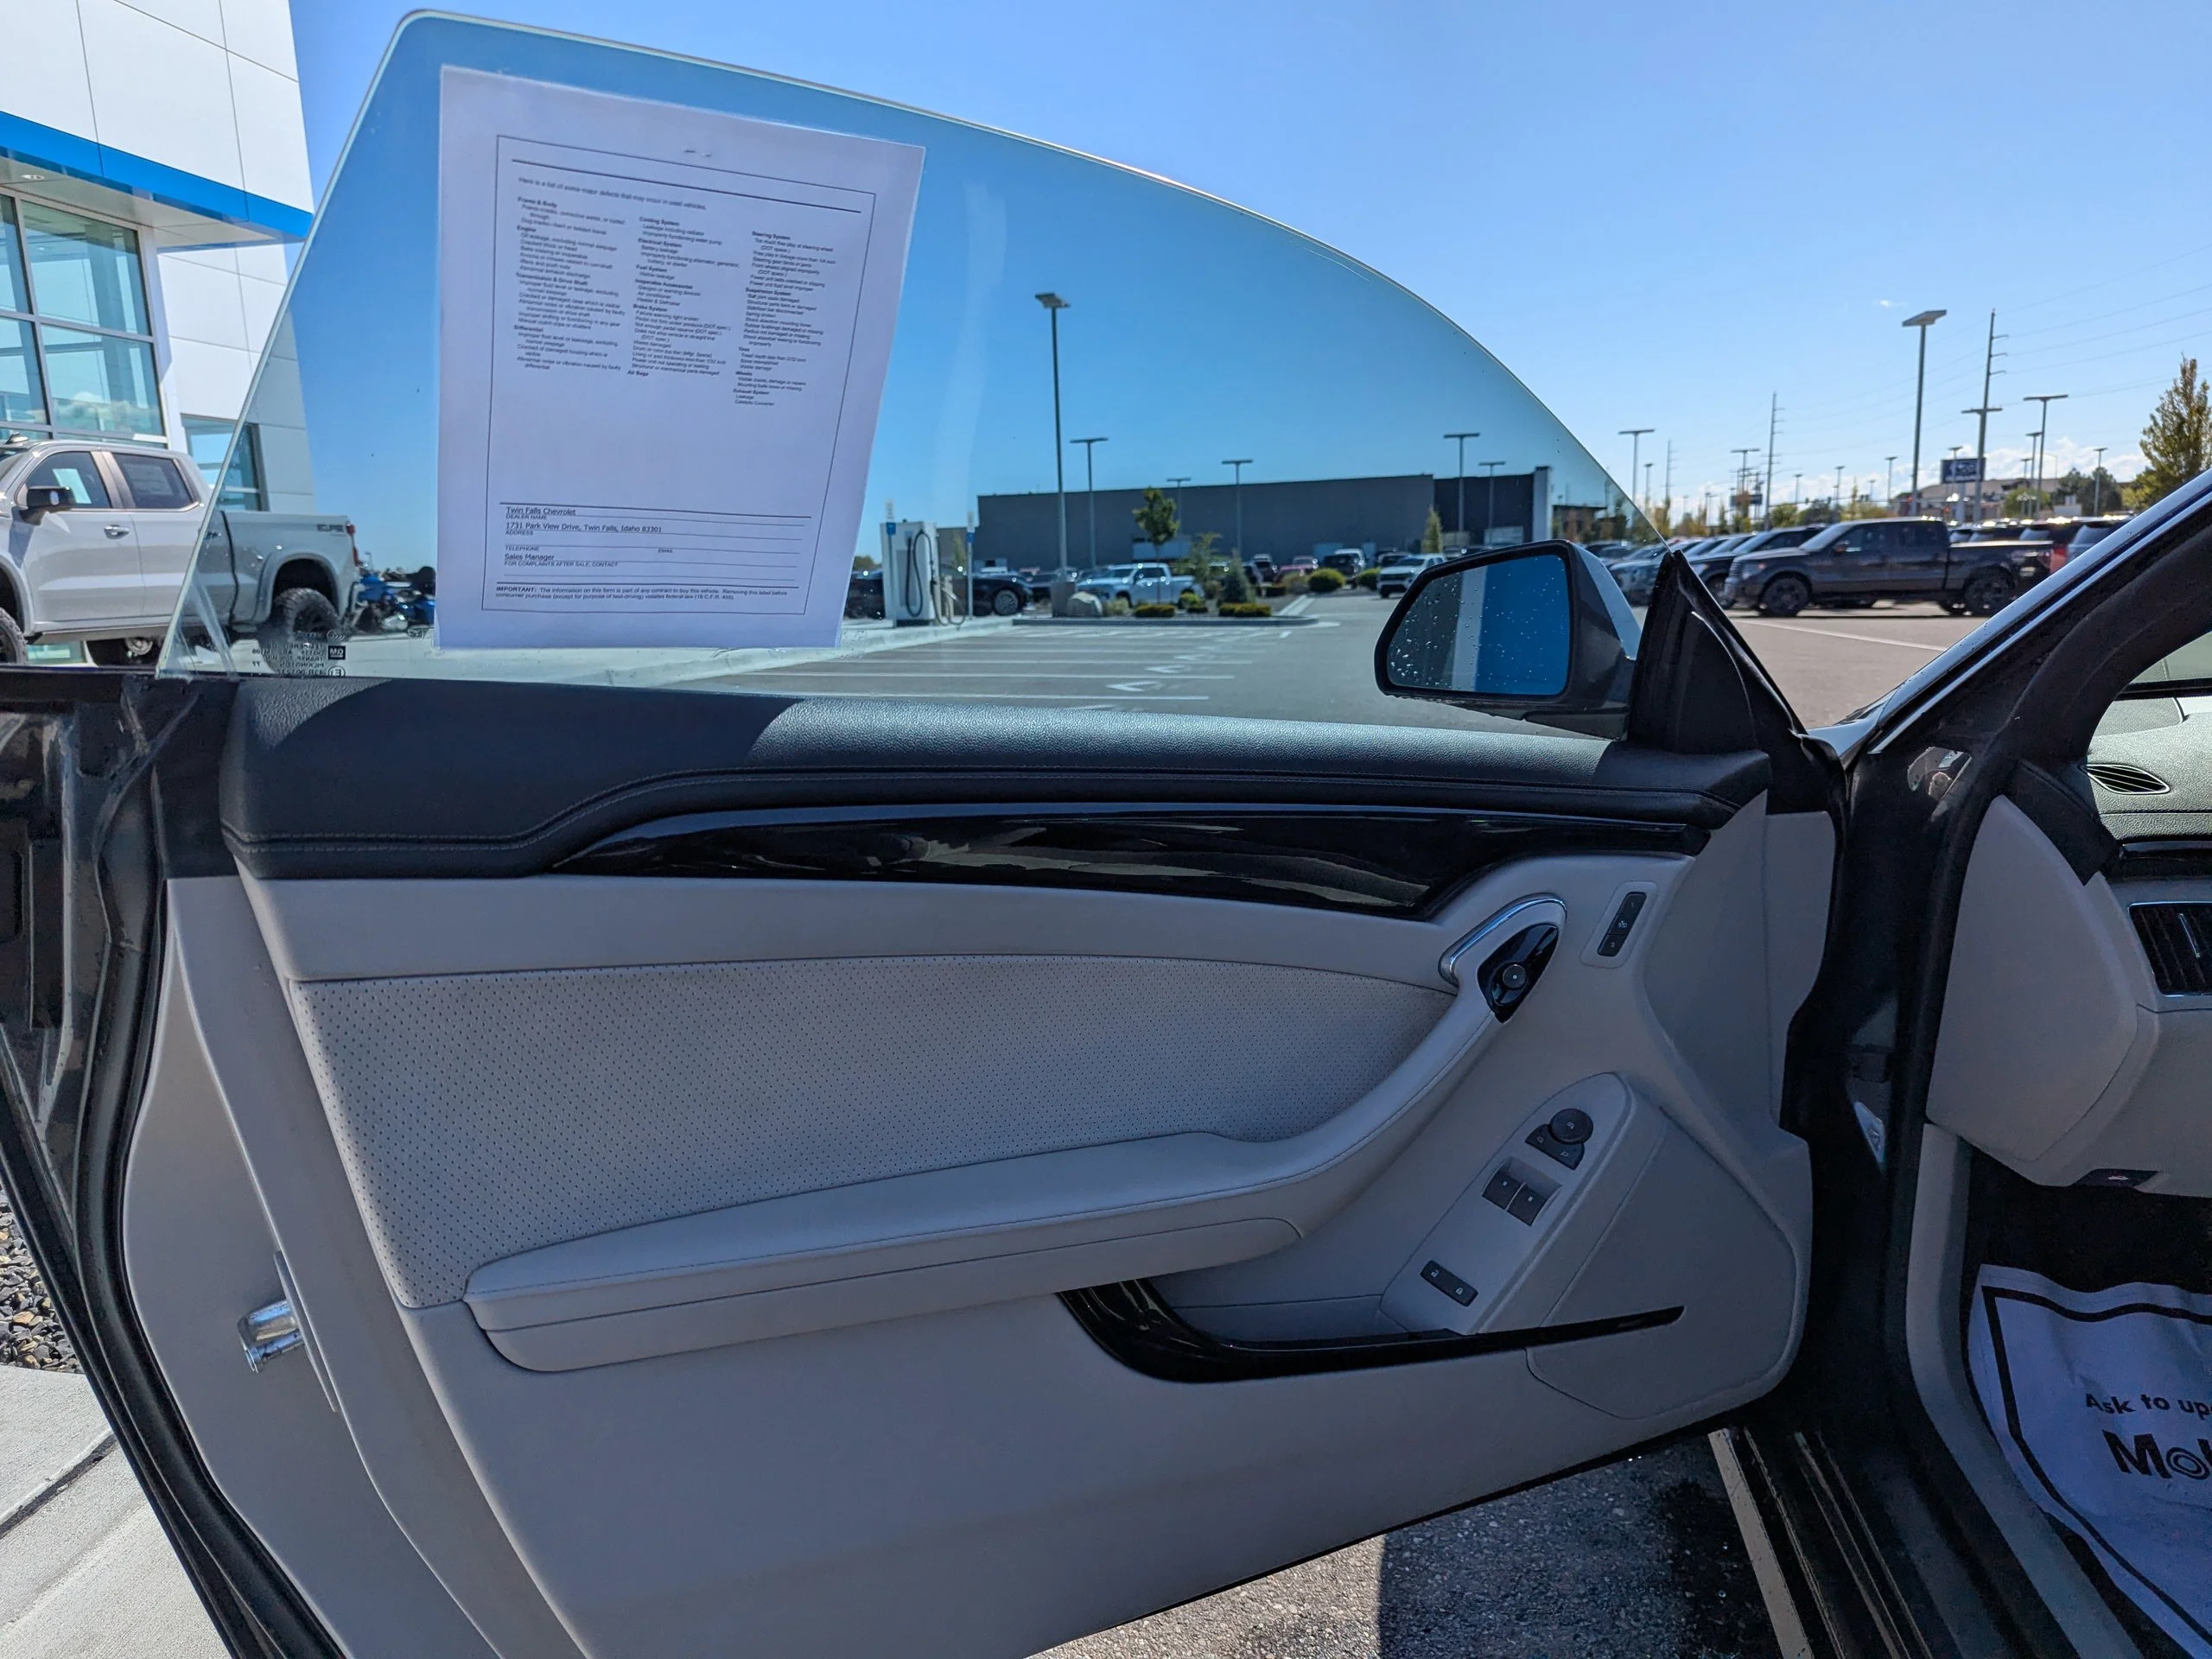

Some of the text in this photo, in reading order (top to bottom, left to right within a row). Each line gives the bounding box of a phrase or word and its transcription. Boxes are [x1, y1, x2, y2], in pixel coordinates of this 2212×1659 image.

[525, 506, 541, 515] Falls
[543, 507, 576, 517] Chevrolet
[2086, 1394, 2212, 1420] Ask to up
